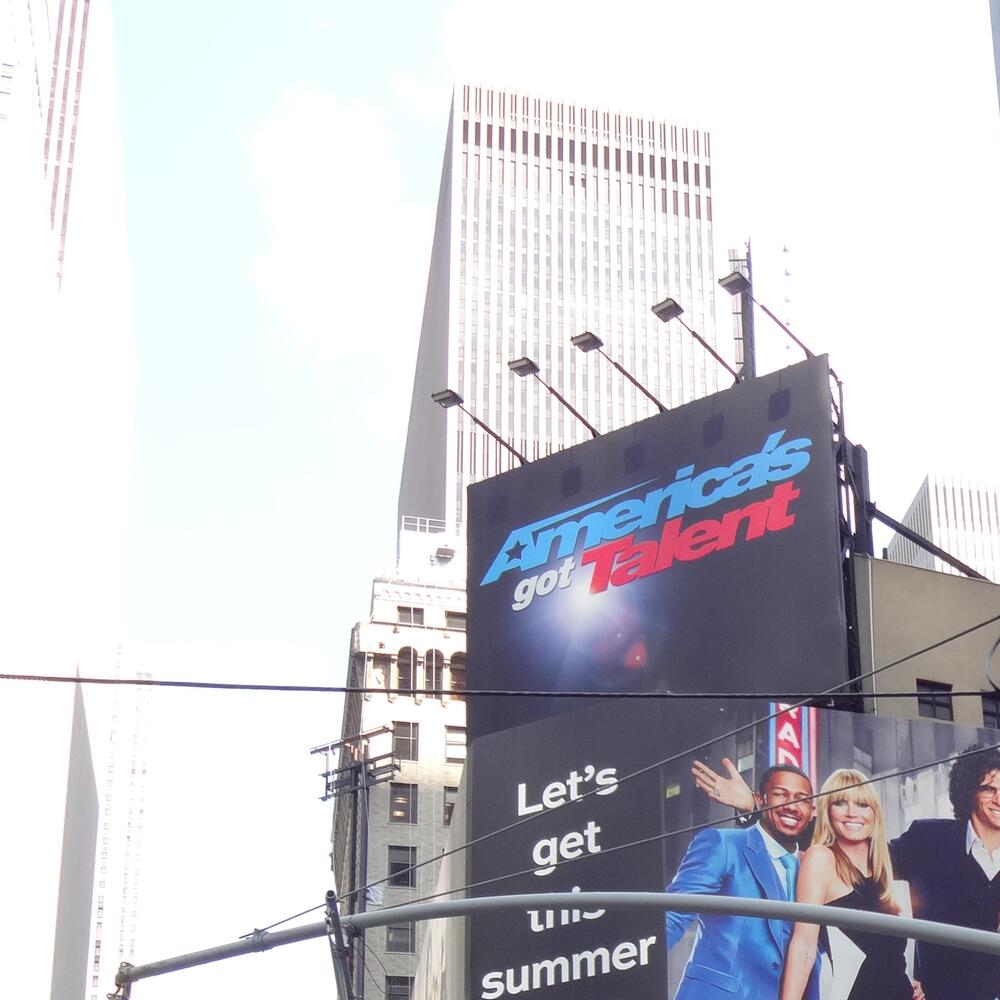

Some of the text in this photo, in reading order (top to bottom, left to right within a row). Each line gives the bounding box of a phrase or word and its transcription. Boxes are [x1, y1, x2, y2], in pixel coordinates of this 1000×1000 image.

[480, 429, 812, 587] America's
[512, 480, 801, 612] got Talent
[517, 765, 619, 816] Let's
[532, 821, 602, 876] get
[481, 936, 657, 1000] summer
